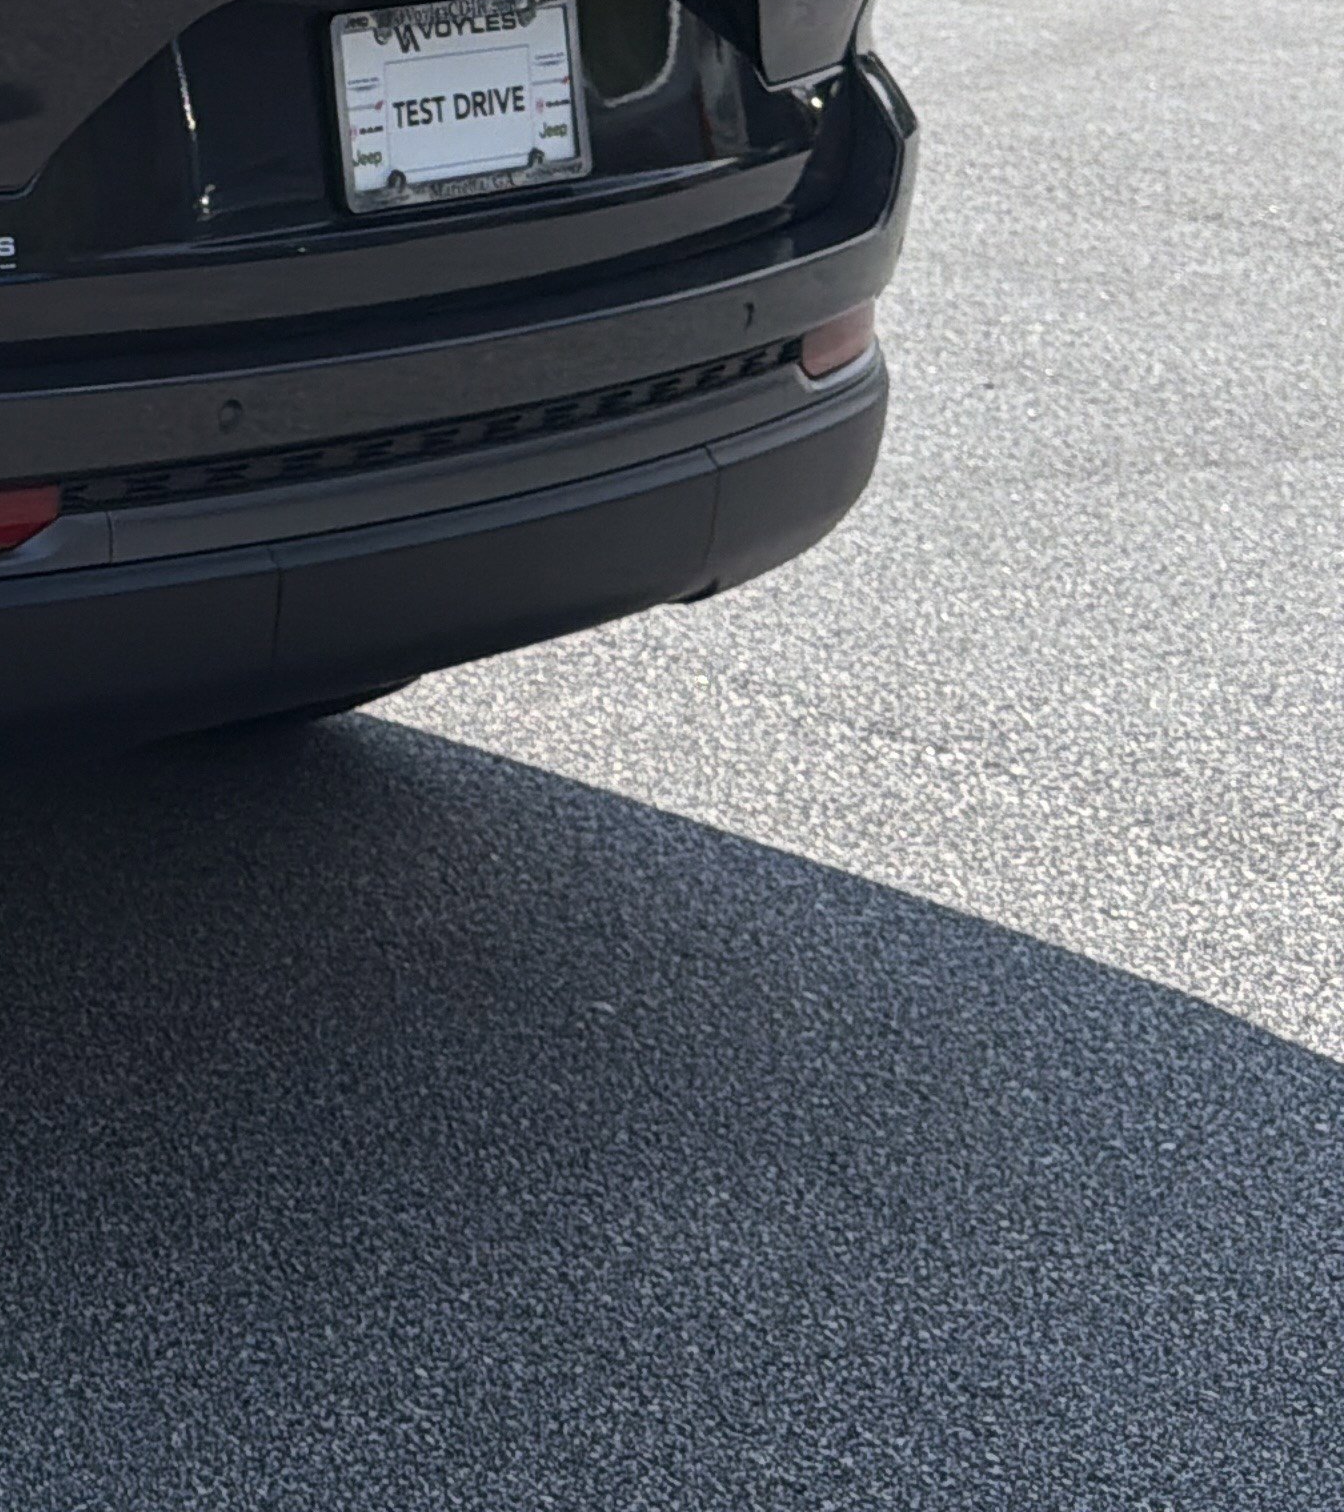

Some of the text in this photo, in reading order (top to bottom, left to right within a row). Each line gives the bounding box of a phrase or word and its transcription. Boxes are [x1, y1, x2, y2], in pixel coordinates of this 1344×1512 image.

[418, 12, 517, 40] VOYLES
[392, 85, 525, 129] TEST DRIVE
